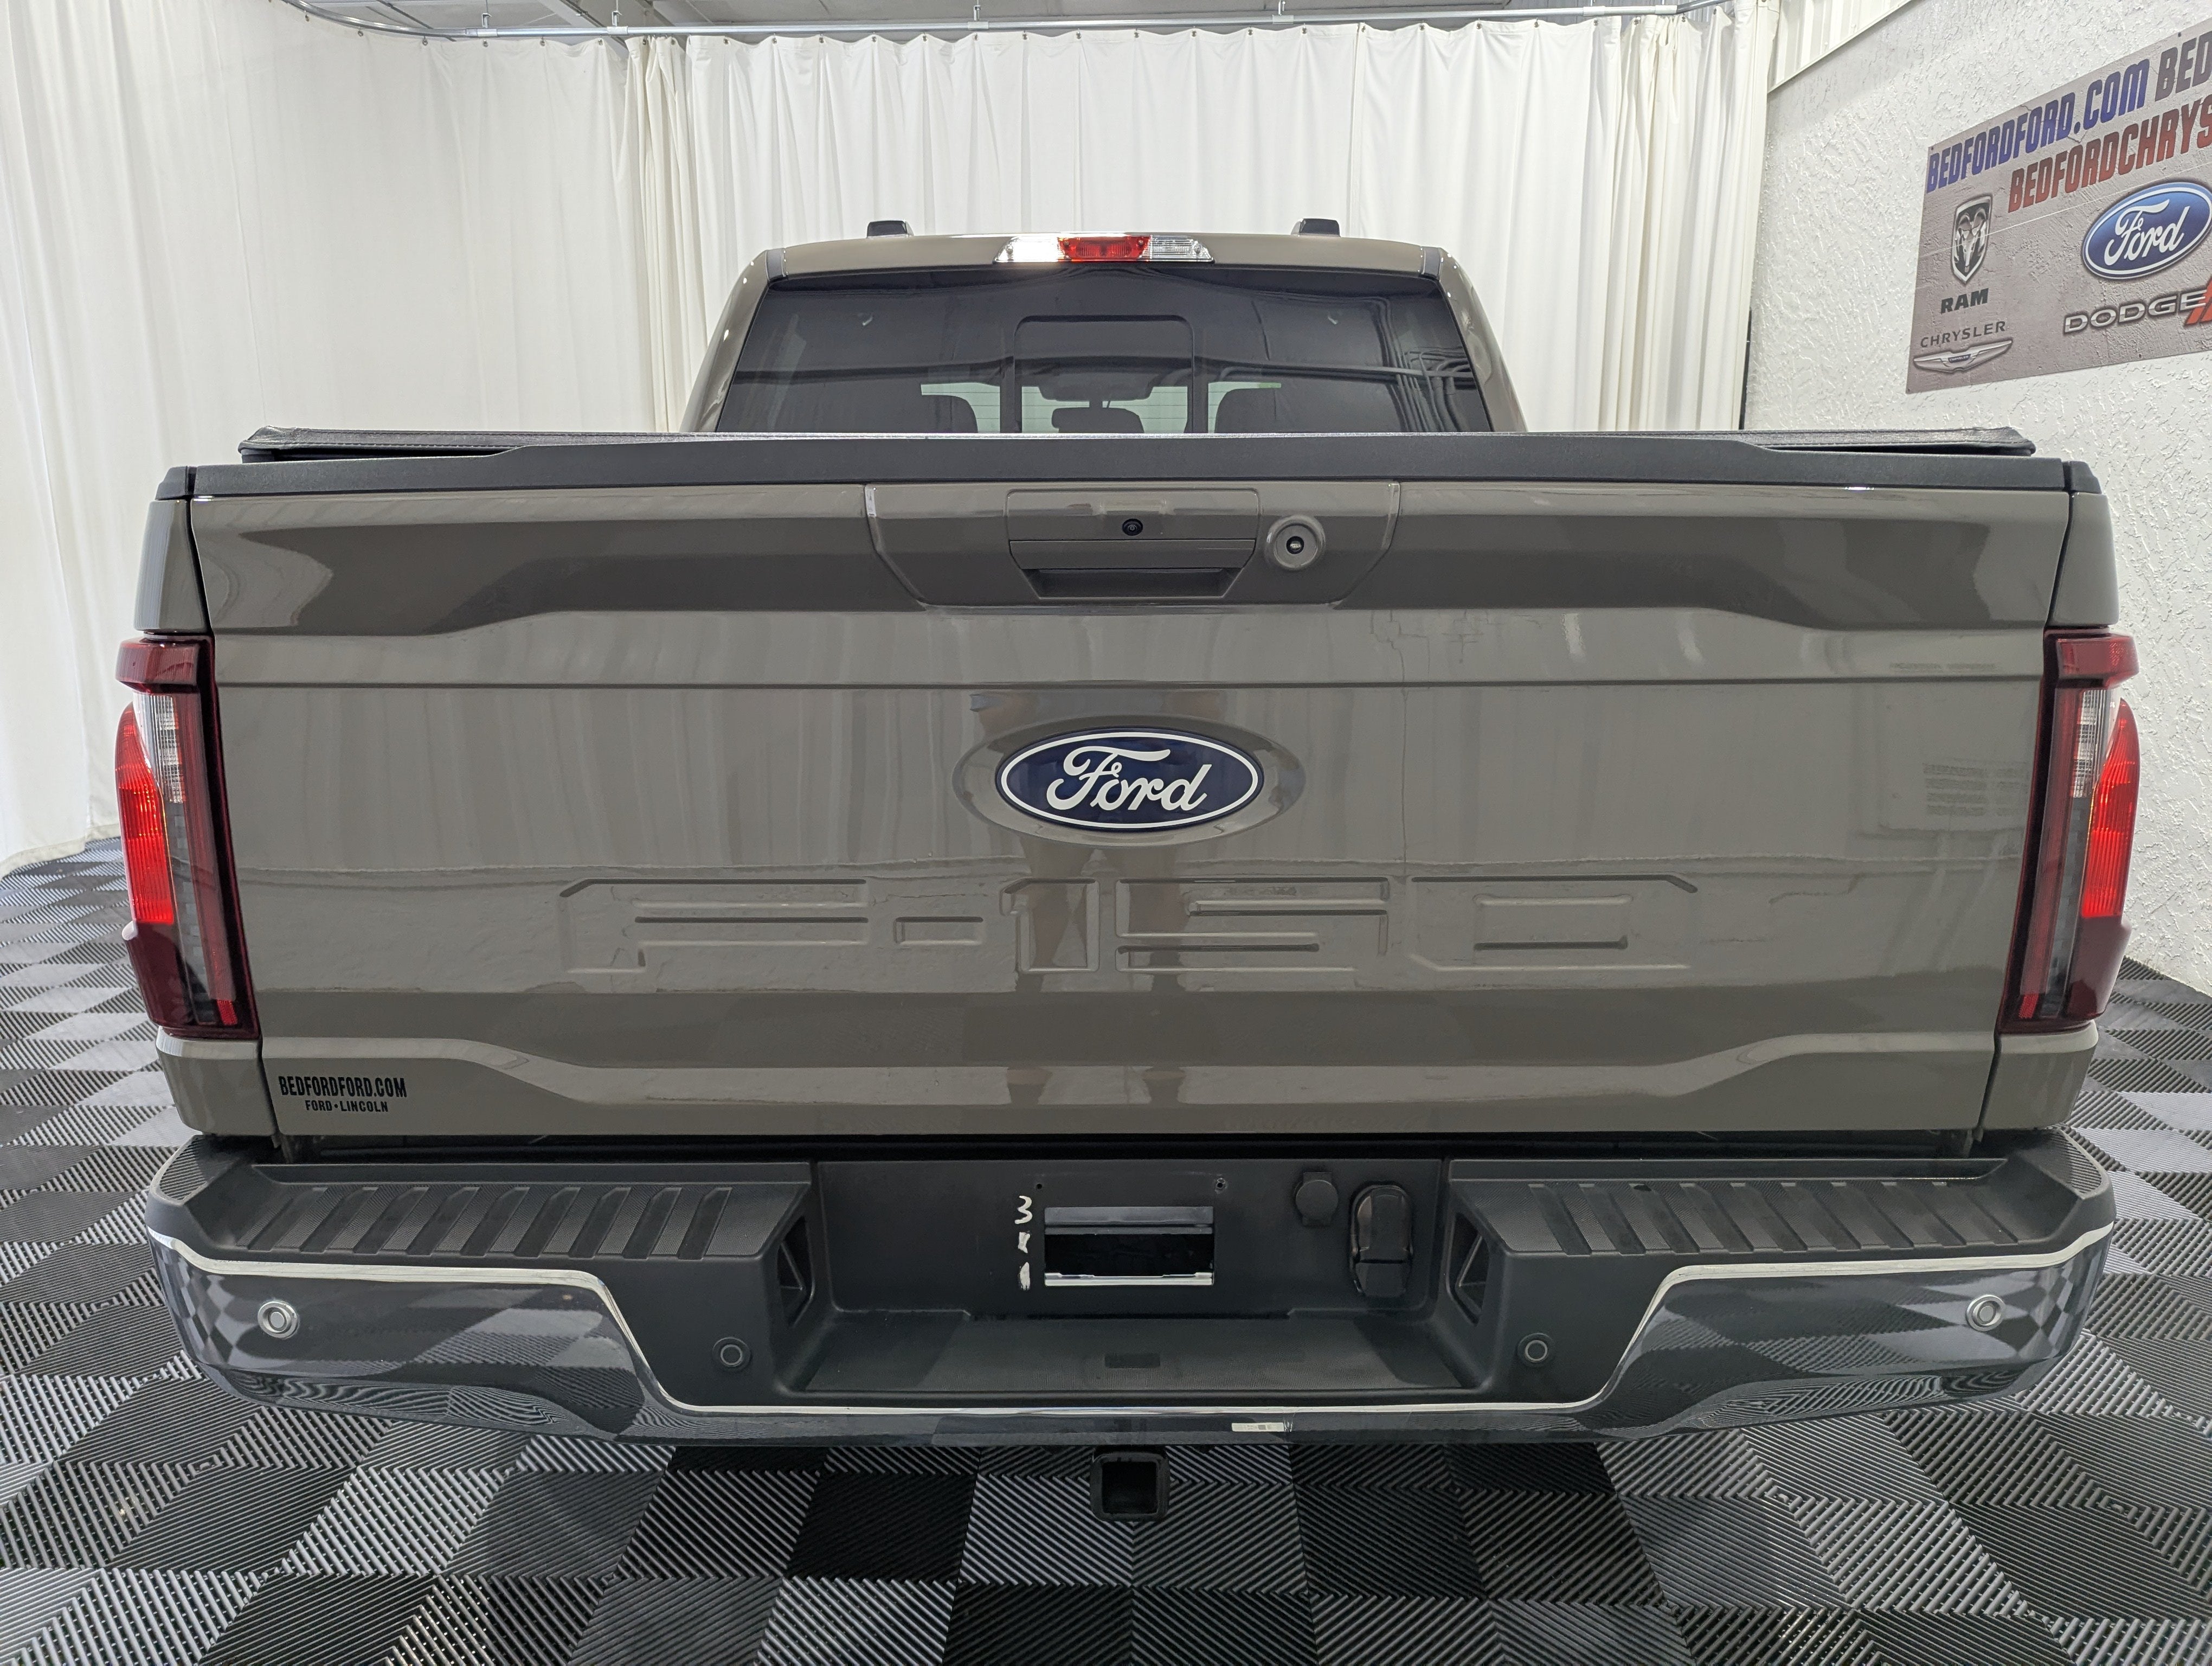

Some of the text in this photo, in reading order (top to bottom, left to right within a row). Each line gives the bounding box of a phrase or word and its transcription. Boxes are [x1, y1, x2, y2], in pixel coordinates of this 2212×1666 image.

[1926, 58, 2150, 193] BEDFORDFORD.COM
[2104, 198, 2190, 261] Ford
[1940, 287, 1989, 314] RAM
[2064, 289, 2207, 332] DODGE
[1920, 321, 2006, 348] CHRYSLER
[1046, 745, 1212, 811] Ford
[278, 1075, 407, 1098] BEDFORDFORD.COM
